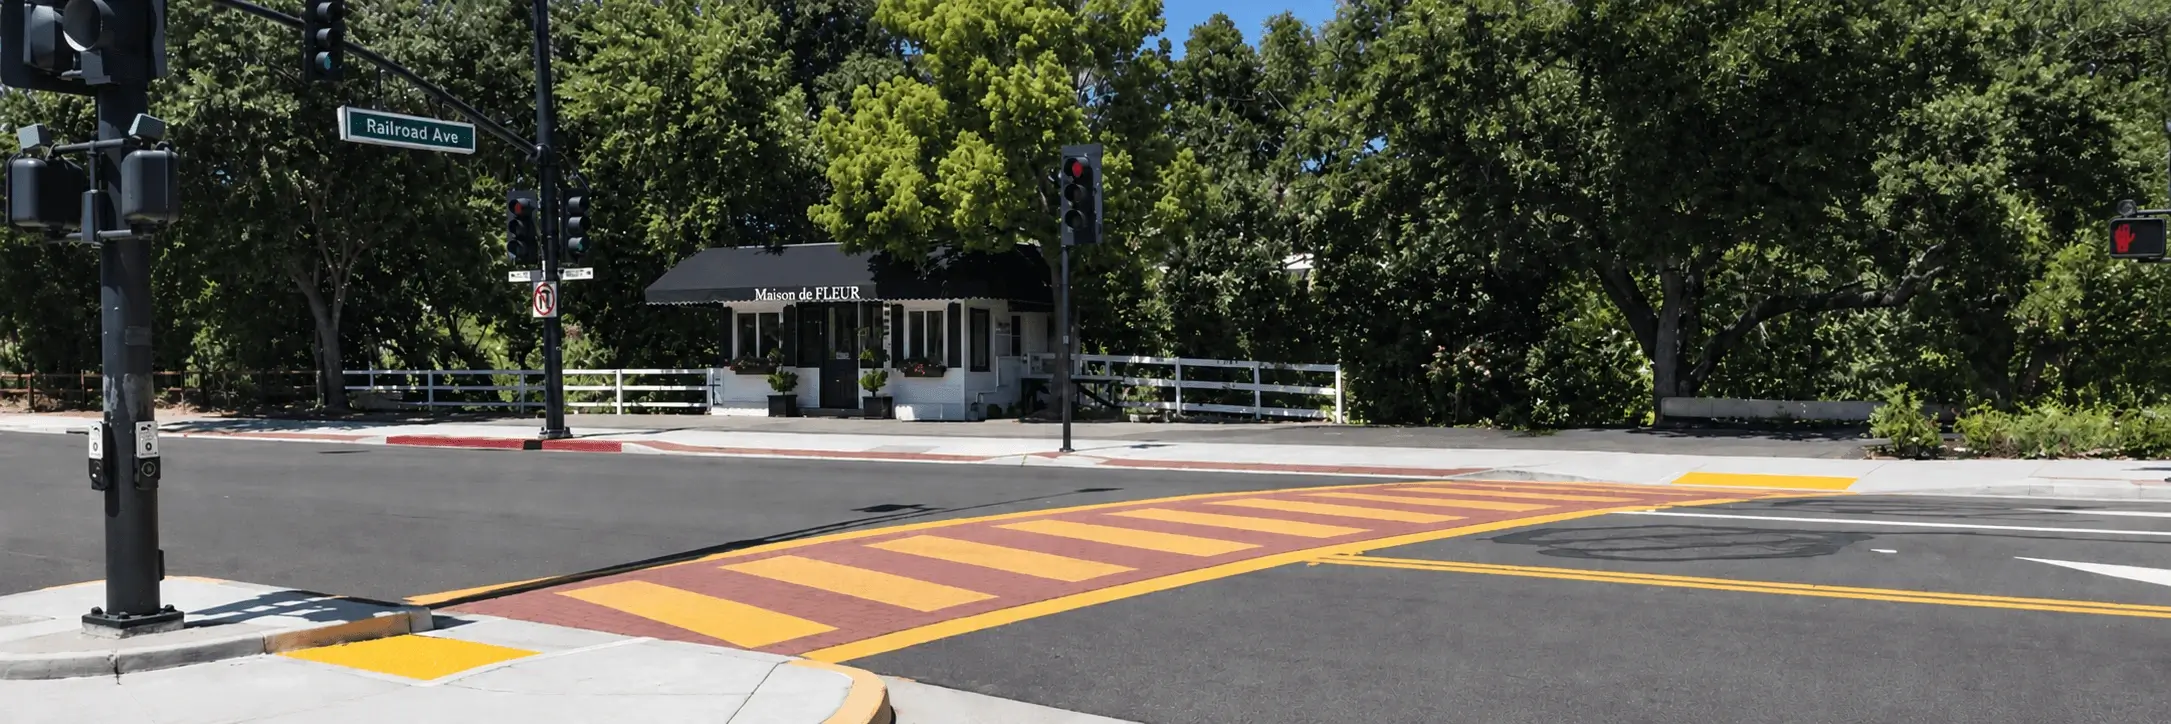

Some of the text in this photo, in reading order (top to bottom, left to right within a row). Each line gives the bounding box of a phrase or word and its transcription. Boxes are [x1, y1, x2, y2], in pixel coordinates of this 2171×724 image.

[366, 118, 458, 144] Railroad Ave
[755, 286, 860, 301] Maison de FLEUR
